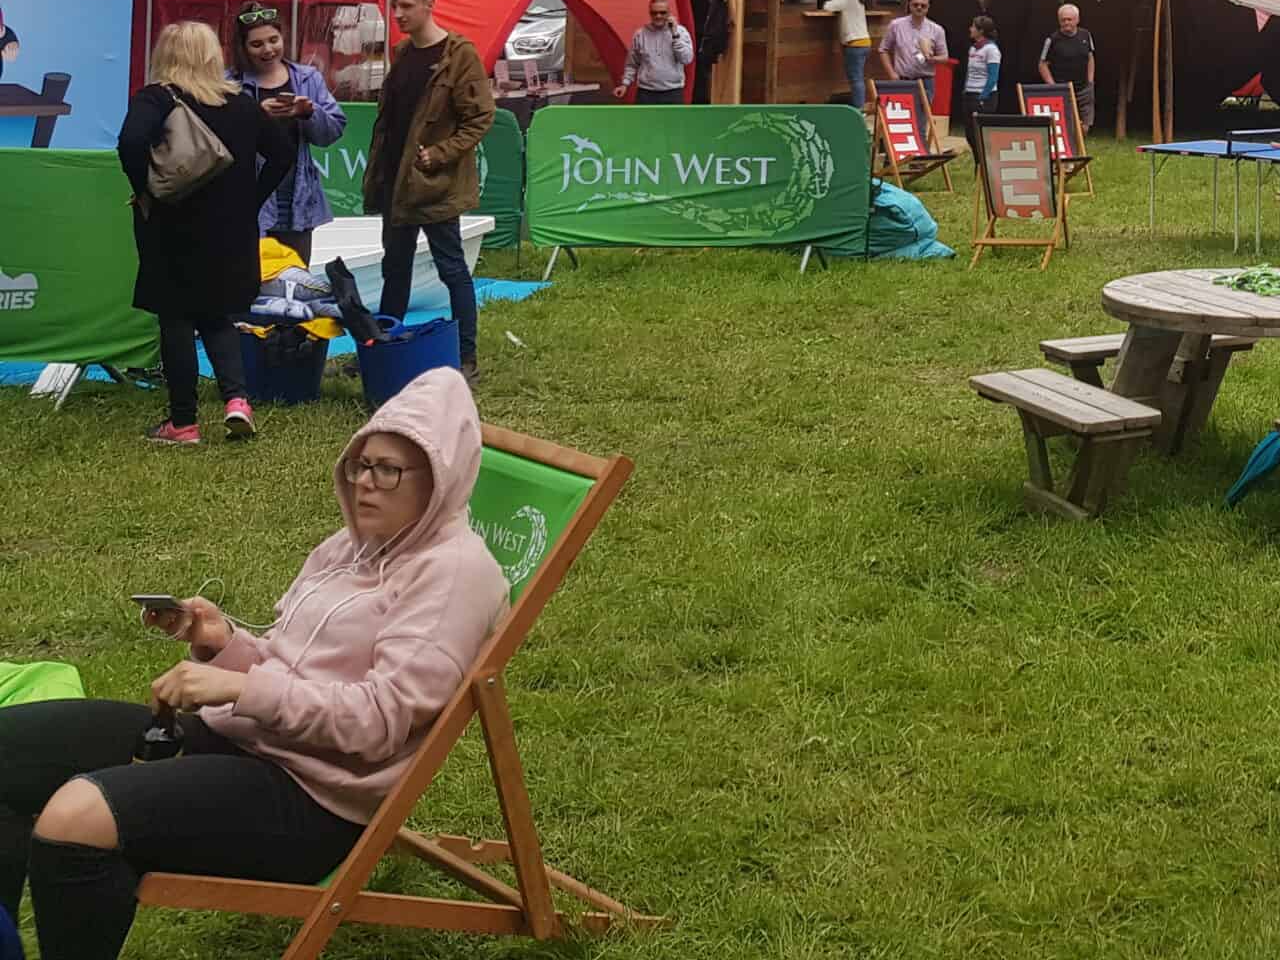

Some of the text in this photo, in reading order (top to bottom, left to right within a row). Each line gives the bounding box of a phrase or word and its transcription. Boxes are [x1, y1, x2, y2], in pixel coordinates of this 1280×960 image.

[886, 101, 921, 160] LIF
[560, 152, 777, 193] JOHN WEST
[470, 517, 527, 553] HN WEST
